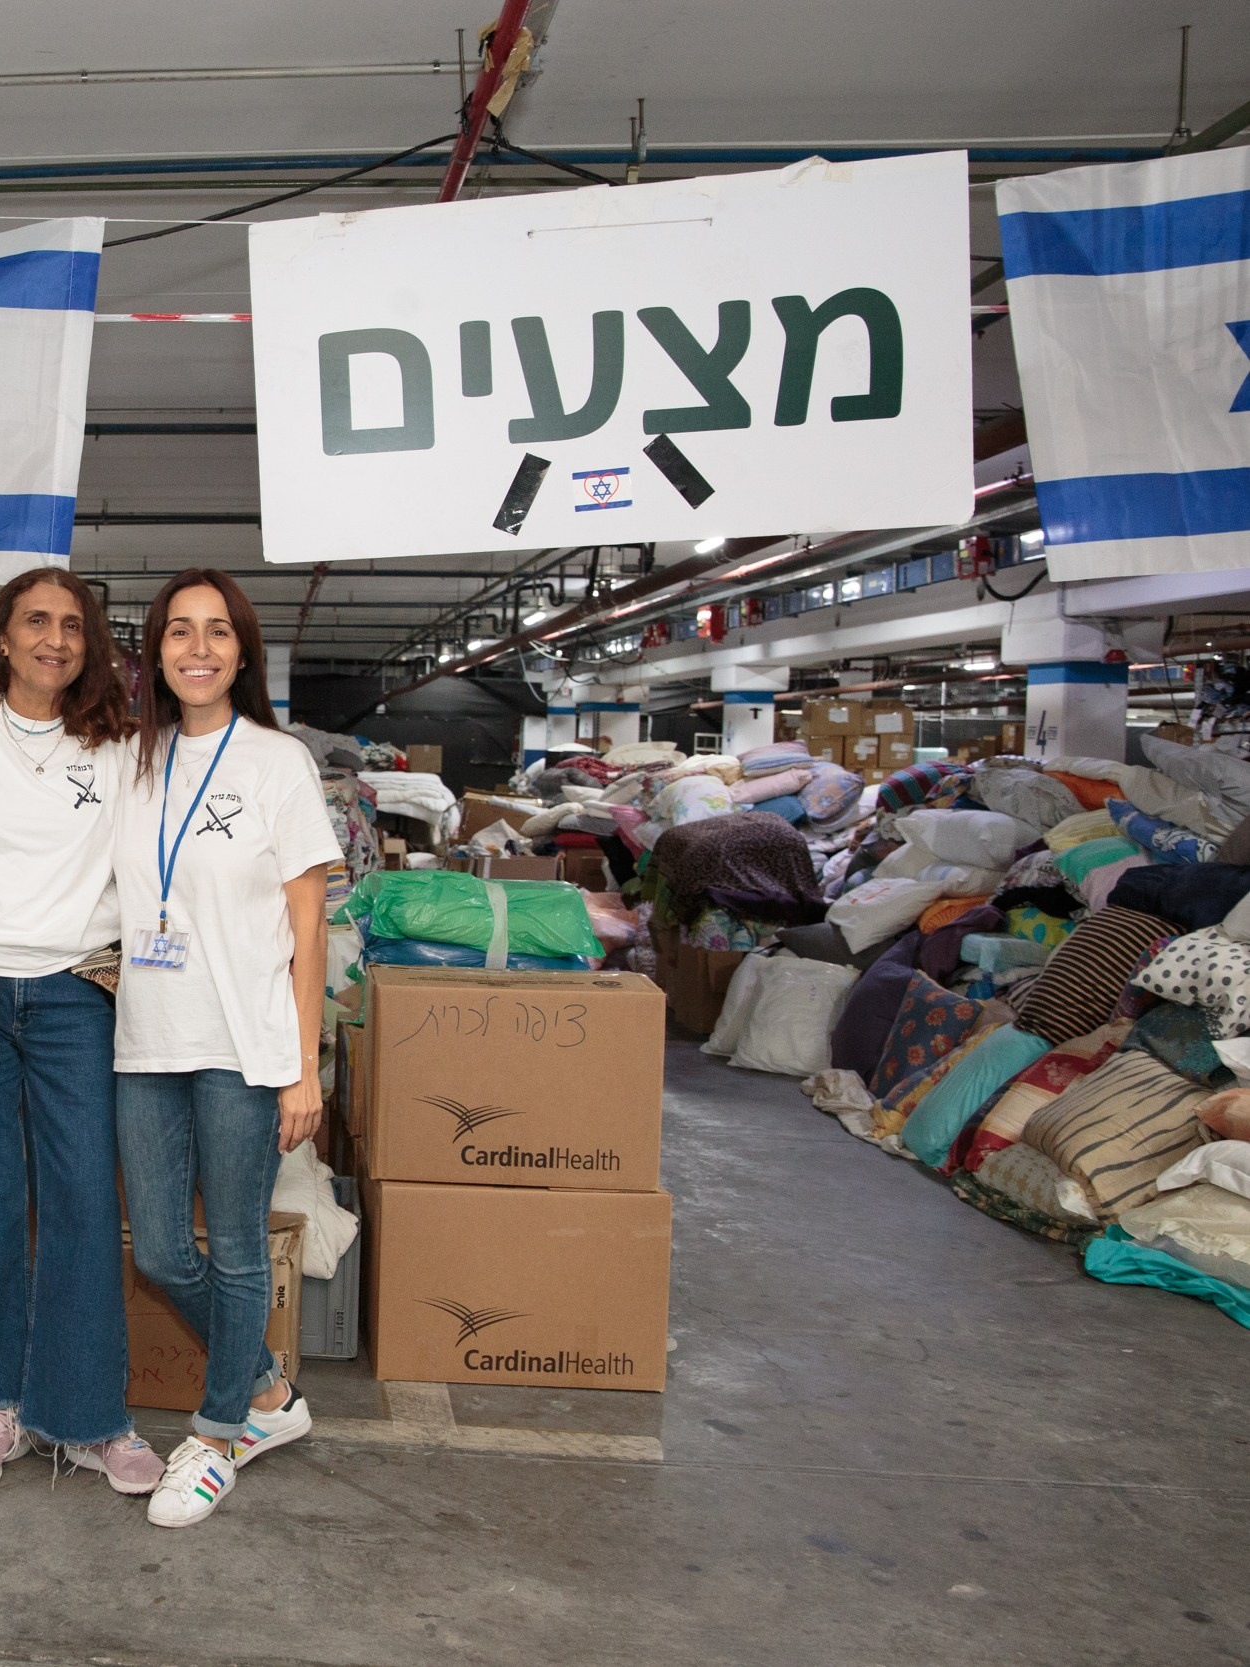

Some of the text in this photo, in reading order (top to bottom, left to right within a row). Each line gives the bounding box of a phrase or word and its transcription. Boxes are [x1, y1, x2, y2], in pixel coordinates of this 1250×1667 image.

[318, 287, 904, 456] מצעים
[516, 1002, 587, 1048] ציפה
[460, 1145, 620, 1171] CardinalHealth
[464, 1349, 634, 1375] CardinalHealth
